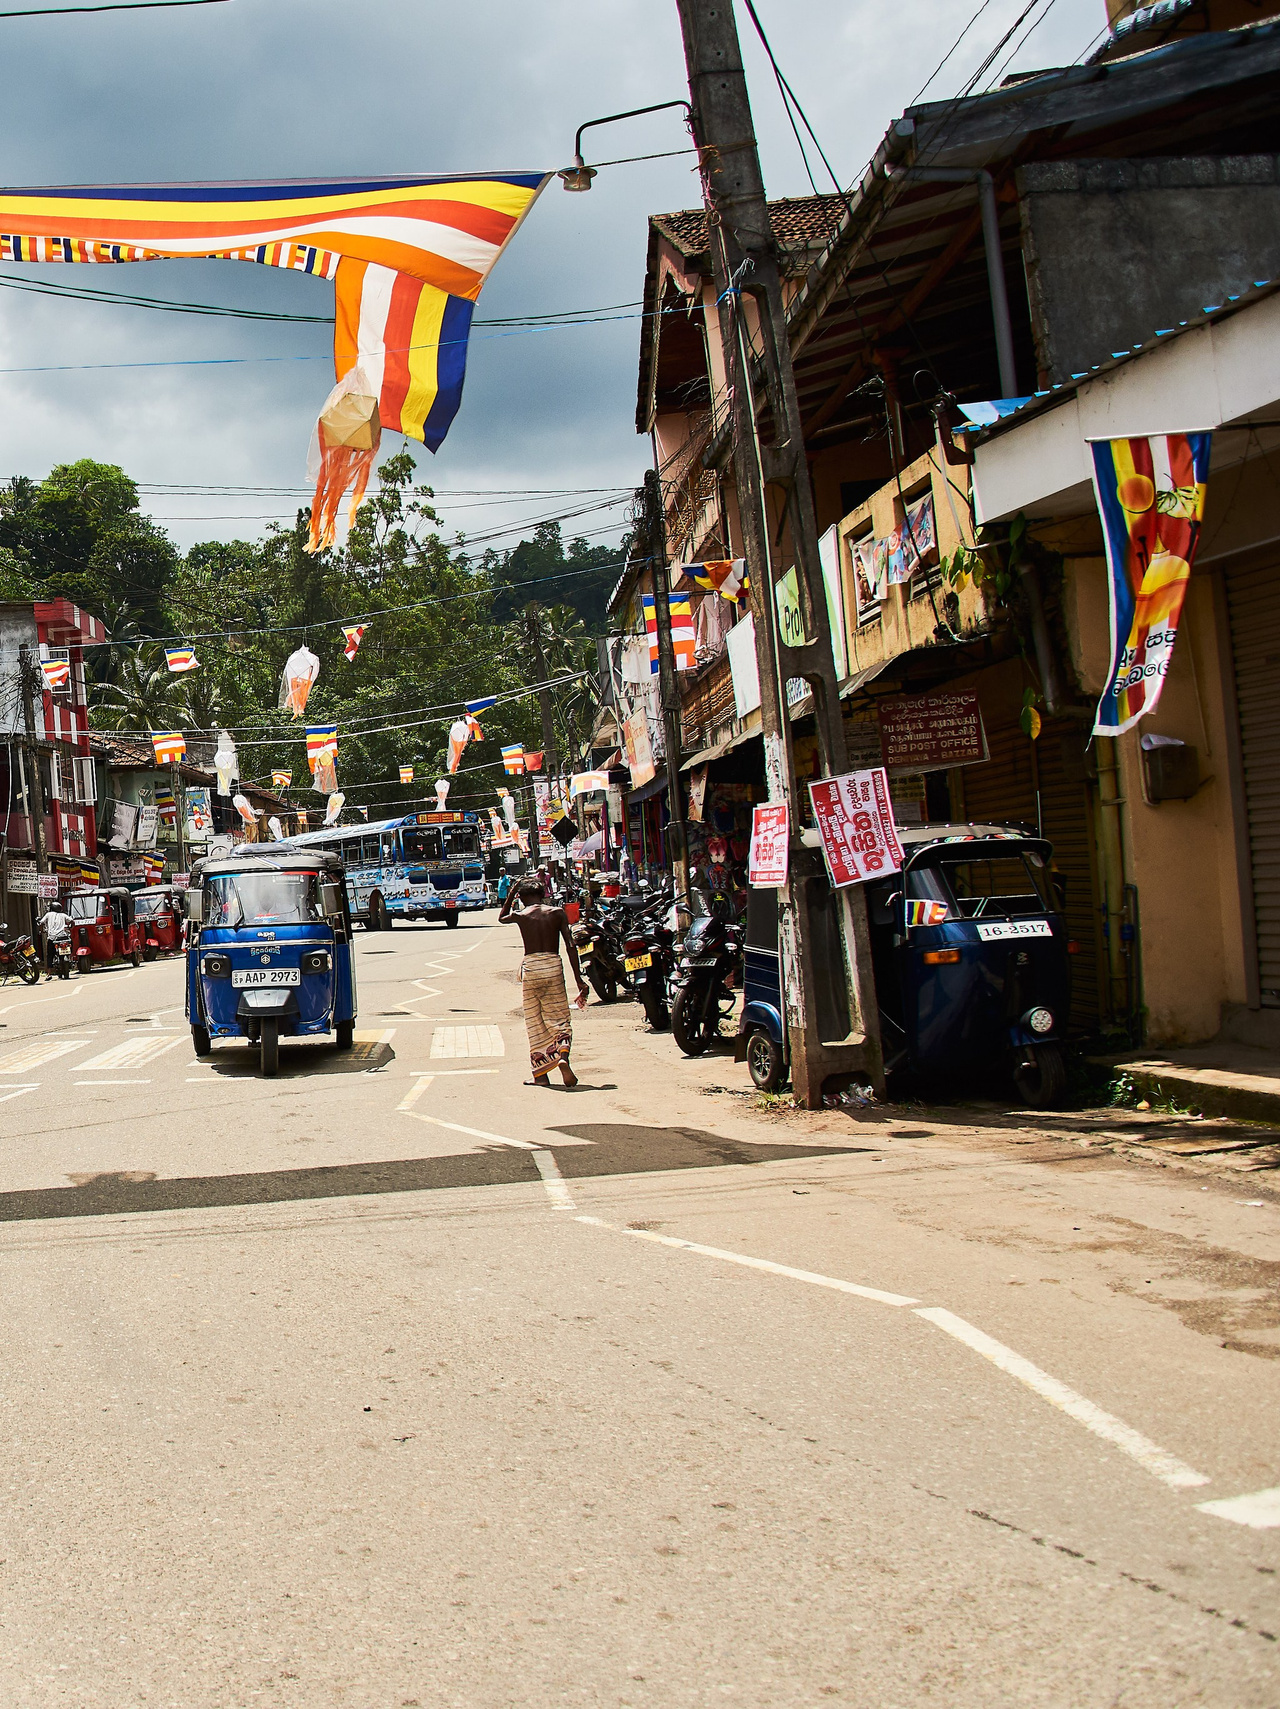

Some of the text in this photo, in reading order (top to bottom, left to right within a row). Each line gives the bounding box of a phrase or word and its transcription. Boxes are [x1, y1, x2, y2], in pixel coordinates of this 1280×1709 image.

[888, 736, 978, 754] SUB POST OFFICE
[942, 748, 978, 759] BAZZAR
[984, 924, 1046, 937] 16-2517
[245, 972, 266, 984] AAP
[270, 971, 298, 982] 2973
